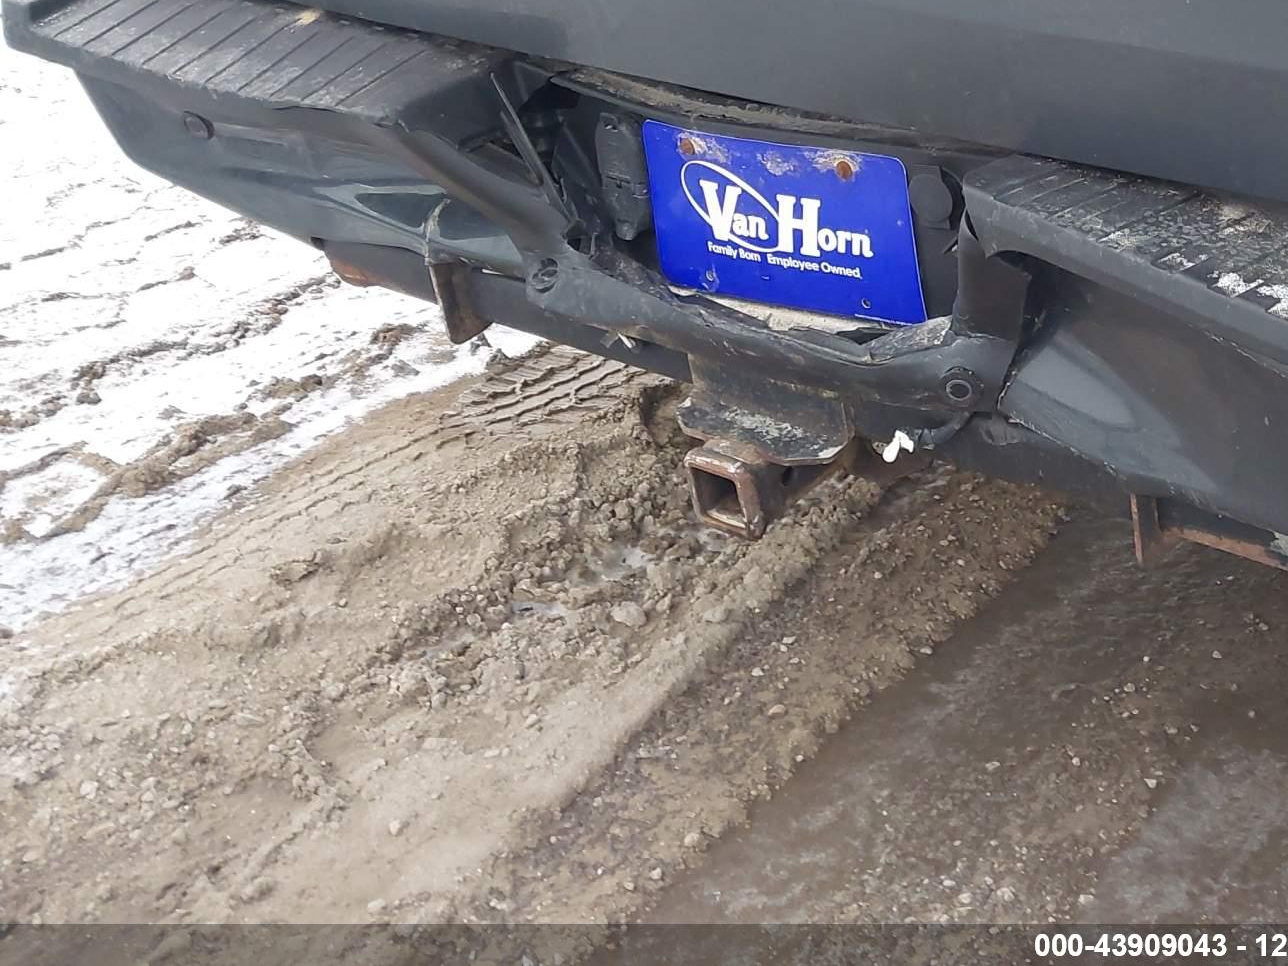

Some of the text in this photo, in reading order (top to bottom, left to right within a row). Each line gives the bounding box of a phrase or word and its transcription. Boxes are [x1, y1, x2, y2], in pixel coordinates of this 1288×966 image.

[699, 179, 874, 258] Van Horn
[707, 241, 738, 260] Family
[739, 248, 761, 263] Born
[766, 253, 820, 272] Employee
